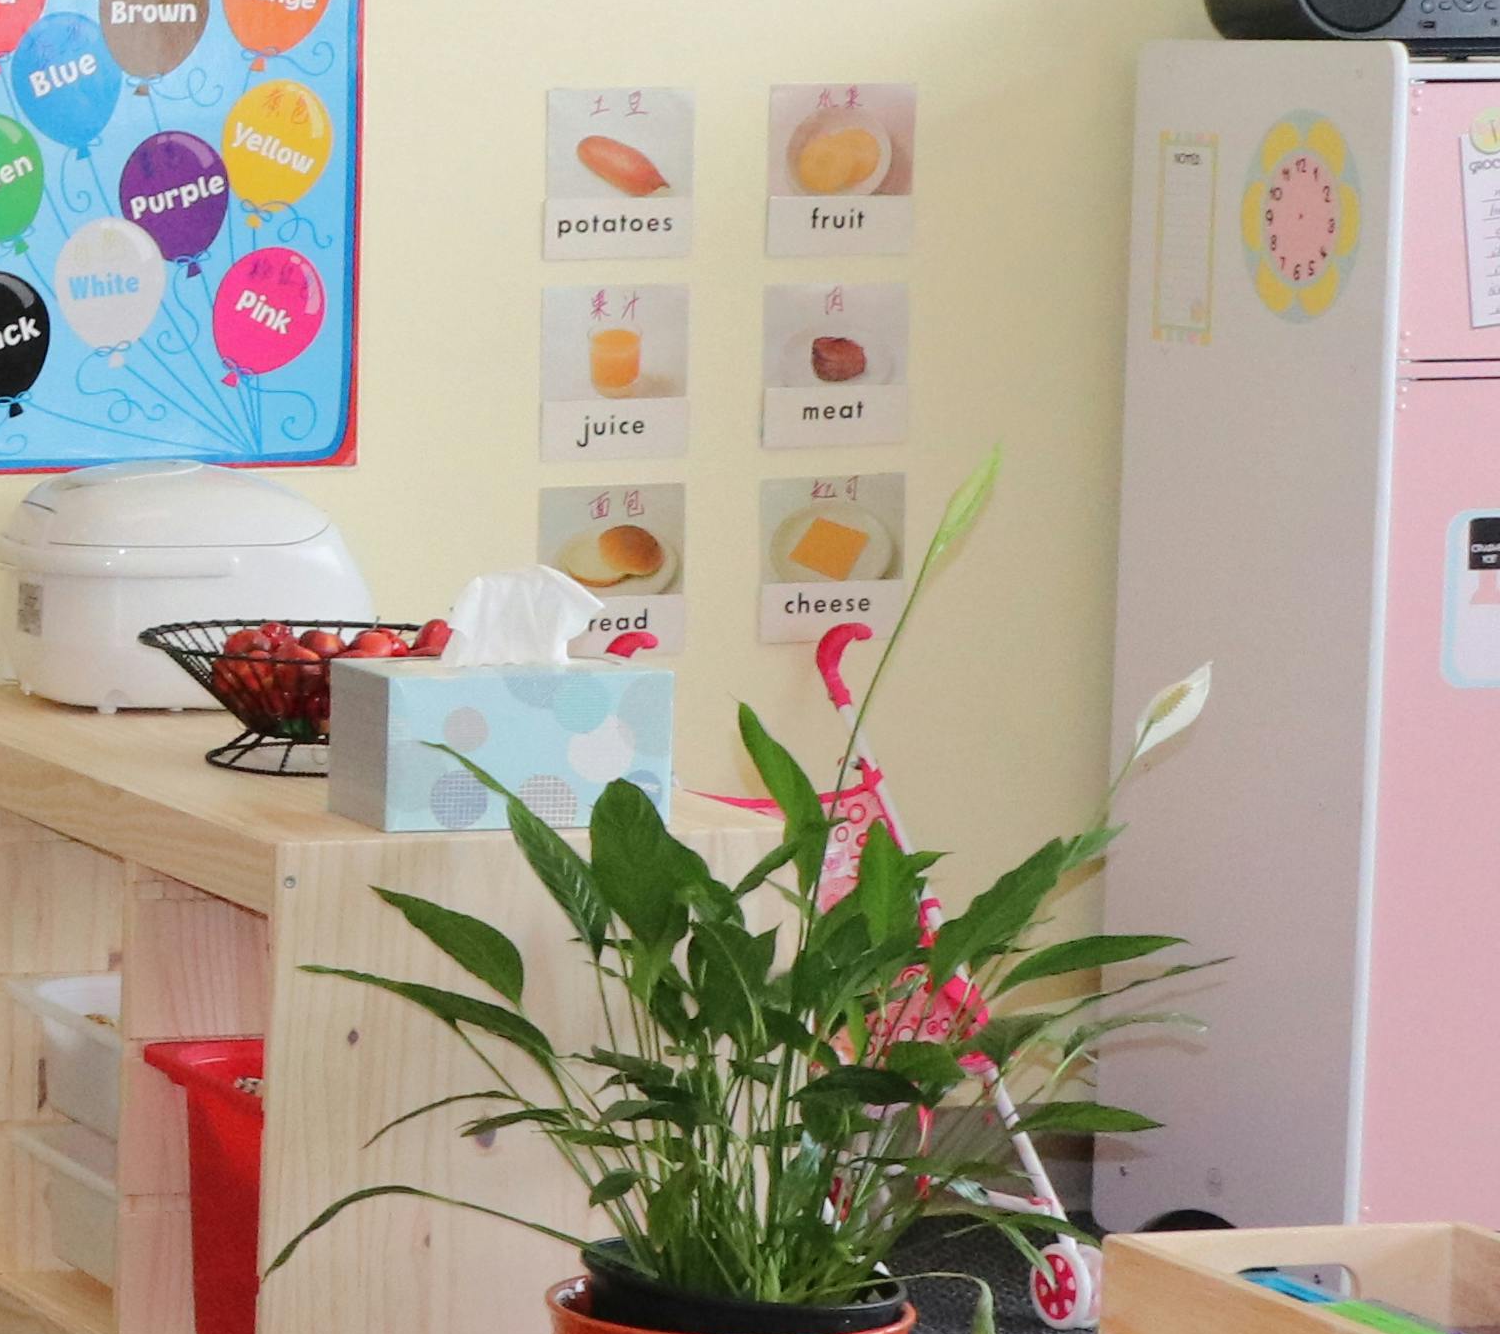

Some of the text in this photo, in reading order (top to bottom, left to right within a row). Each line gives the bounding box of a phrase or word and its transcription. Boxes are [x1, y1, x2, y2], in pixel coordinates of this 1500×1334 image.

[111, 0, 197, 24] Brown
[29, 54, 97, 97] Blue
[590, 90, 651, 117] 土豆
[231, 121, 315, 174] Yellow
[1295, 158, 1306, 173] 12
[130, 175, 226, 220] Purple
[1269, 186, 1282, 201] 10
[1322, 185, 1330, 203] 2
[557, 215, 673, 238] potatoes
[811, 208, 865, 229] fruit
[1265, 209, 1274, 225] 9
[1327, 218, 1336, 234] 3
[1269, 234, 1277, 251] 8
[1279, 256, 1287, 269] 7
[1293, 264, 1302, 281] 6
[1308, 259, 1316, 276] 5
[68, 272, 140, 300] White
[235, 289, 293, 334] Pink
[802, 401, 864, 420] meat
[576, 415, 645, 448] juice
[784, 592, 870, 614] cheese
[588, 609, 648, 633] read
